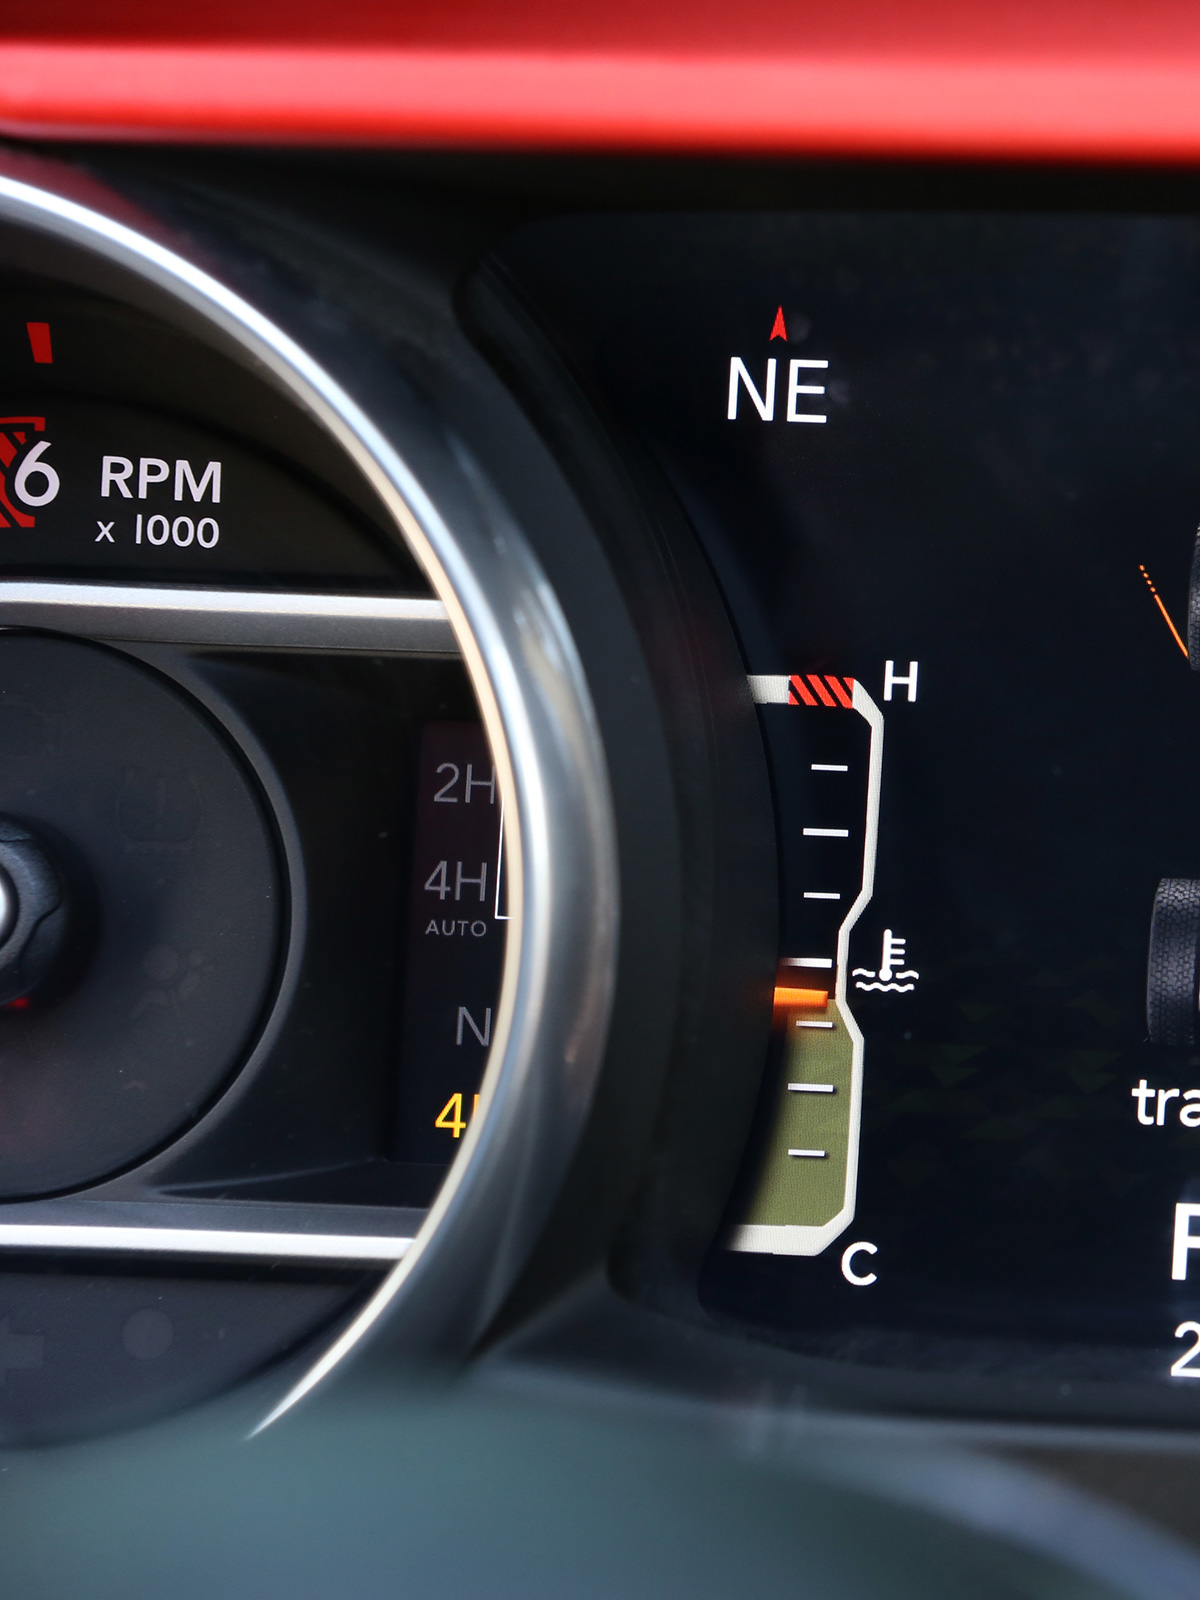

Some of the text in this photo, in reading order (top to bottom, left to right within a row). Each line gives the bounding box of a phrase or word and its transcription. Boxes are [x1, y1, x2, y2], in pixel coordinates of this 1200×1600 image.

[727, 356, 829, 424] NE
[14, 440, 60, 507] 6
[100, 455, 222, 504] RPM
[94, 513, 220, 549] x 1000
[883, 659, 919, 703] H
[433, 762, 497, 805] 2H
[423, 860, 488, 903] 4H
[424, 919, 488, 938] AUTO
[455, 1006, 492, 1048] N
[435, 1092, 481, 1138] 4
[840, 1241, 879, 1287] C
